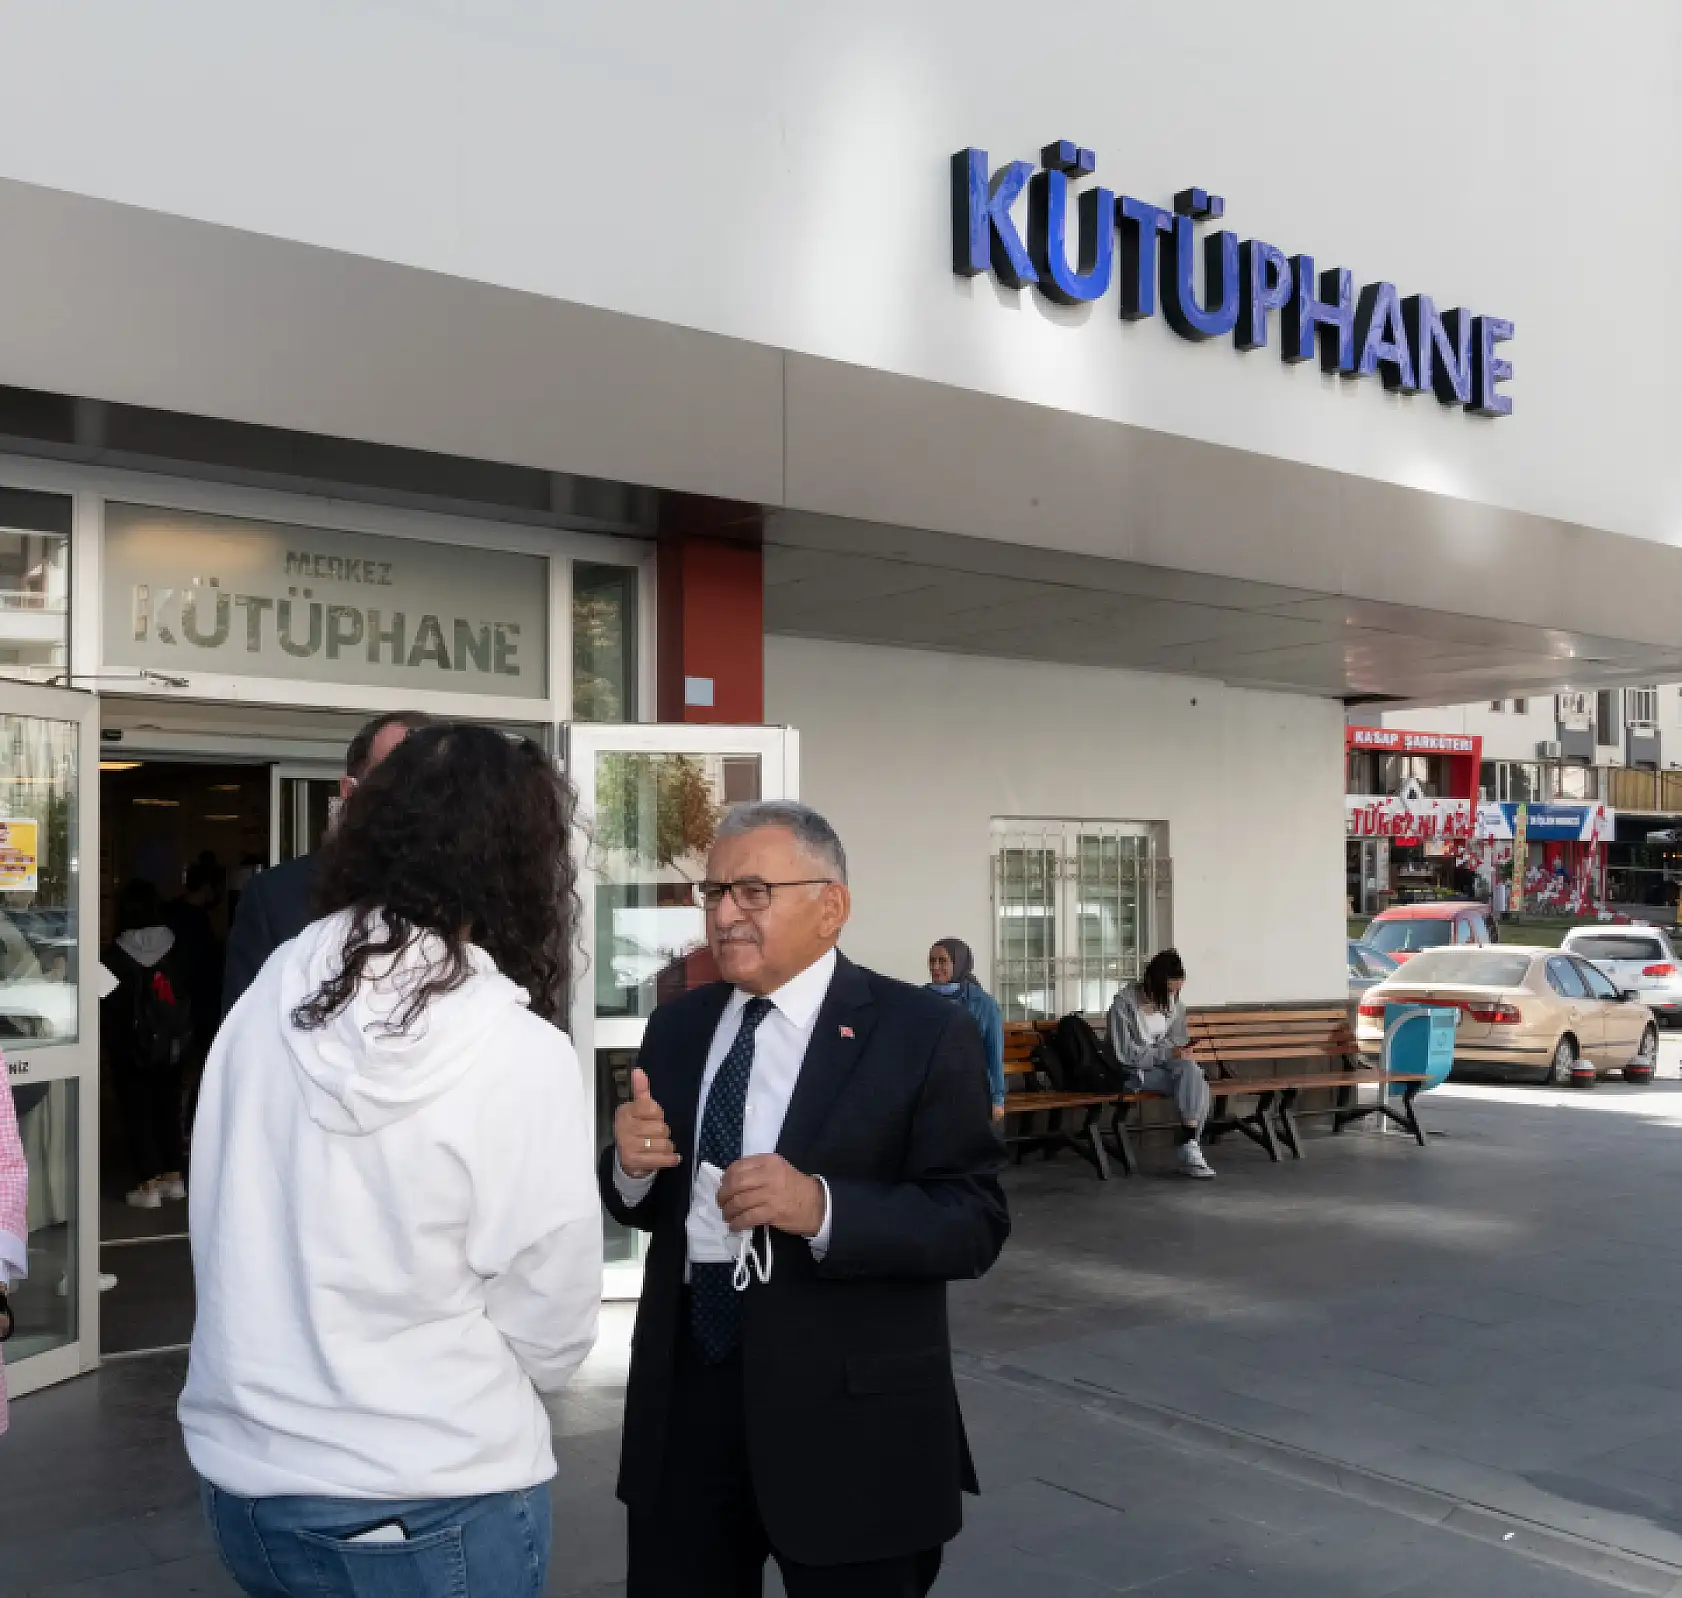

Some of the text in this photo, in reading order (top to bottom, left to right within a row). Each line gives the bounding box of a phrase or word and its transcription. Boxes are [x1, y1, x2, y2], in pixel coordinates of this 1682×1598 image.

[951, 140, 1515, 417] KÜTÜPHANE
[285, 550, 393, 586] MERKEZ
[132, 577, 521, 676] KÜTÜPHANE
